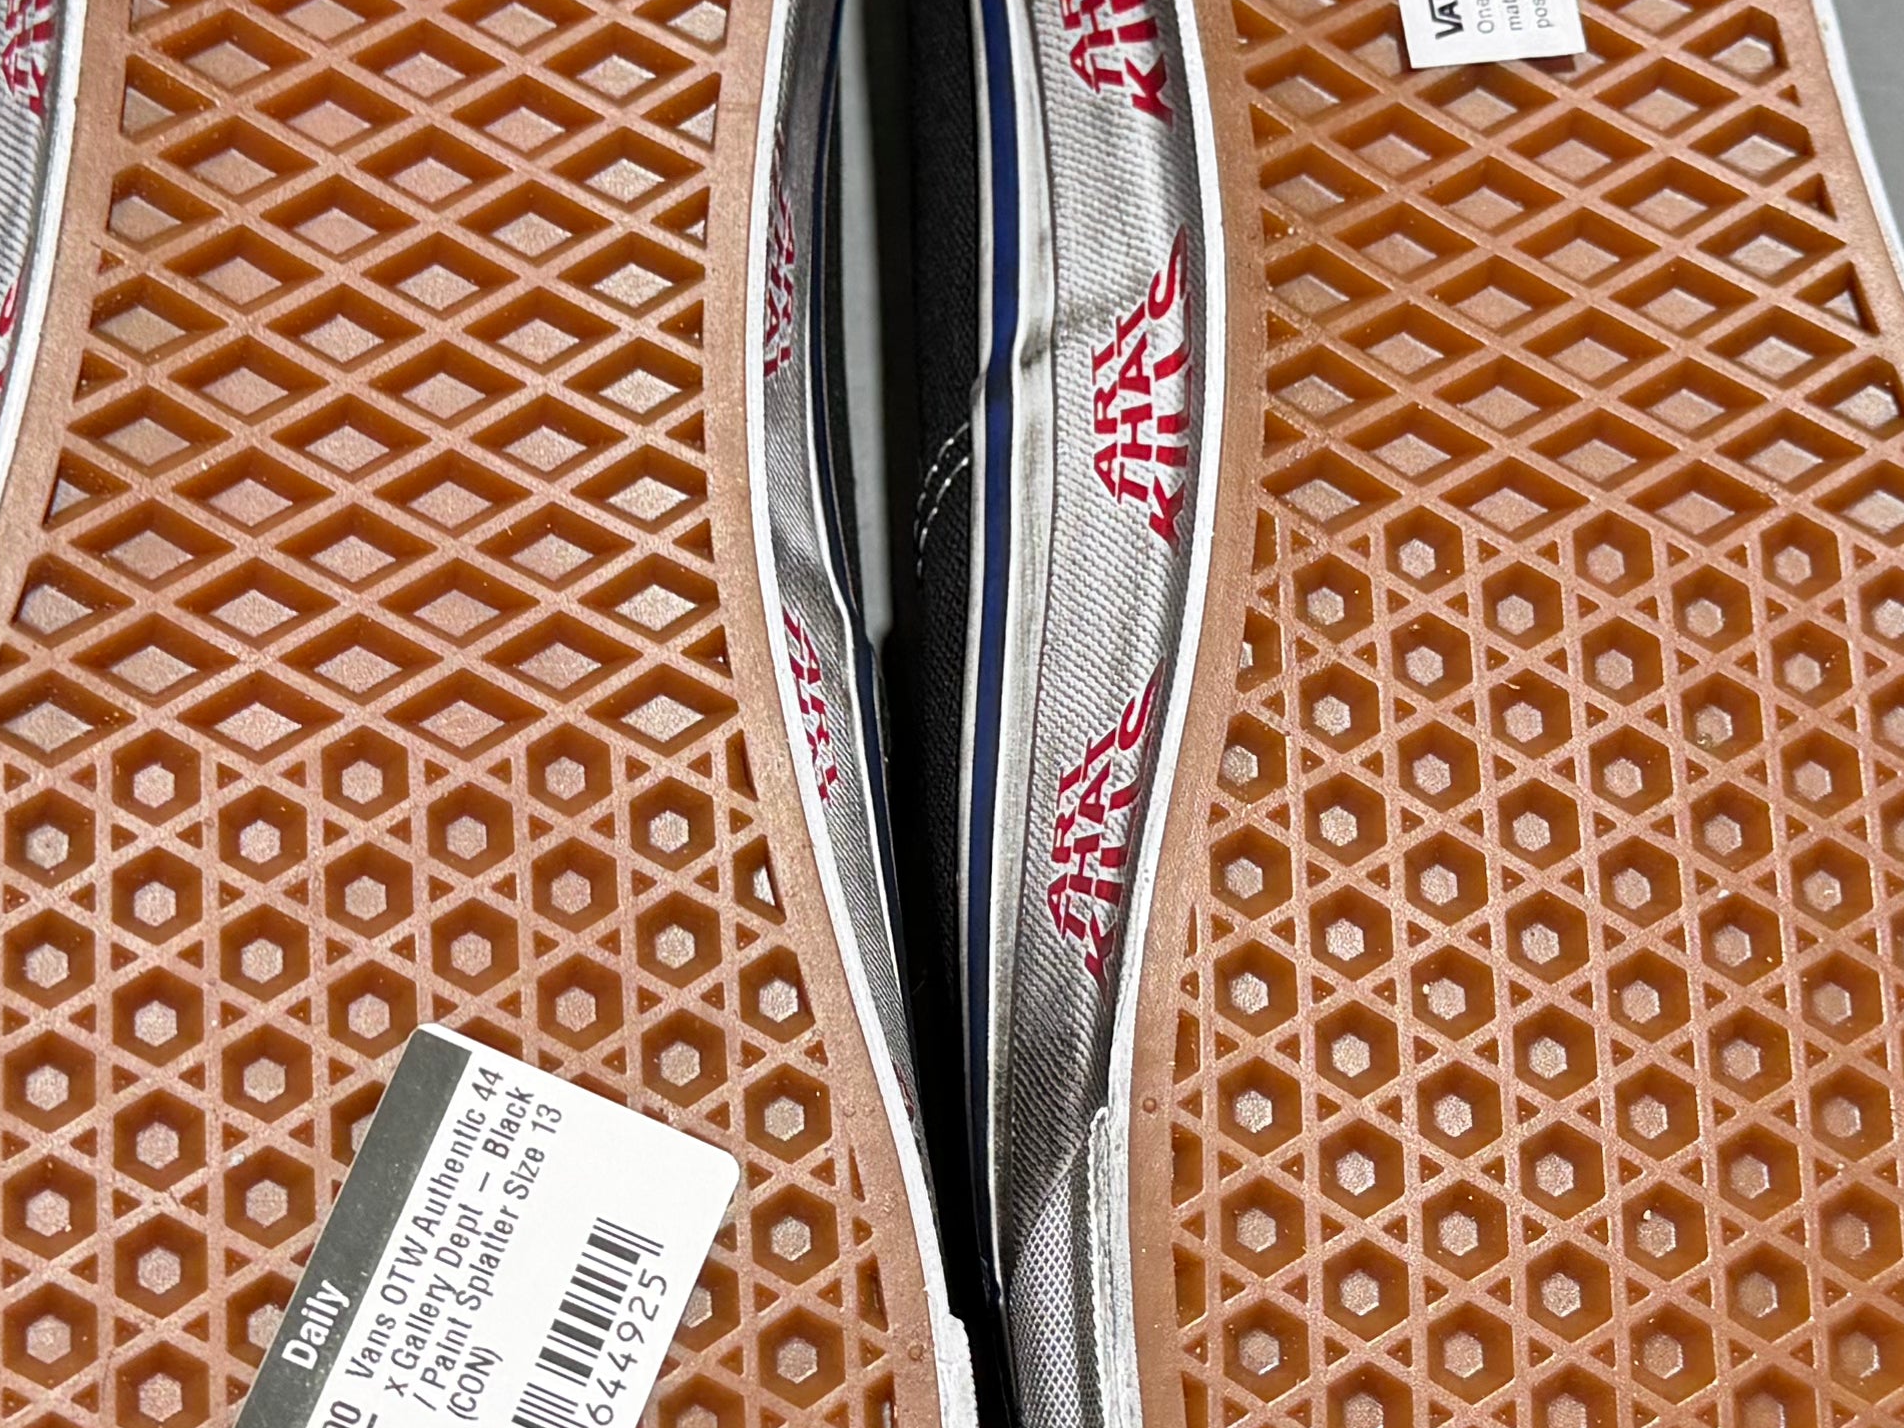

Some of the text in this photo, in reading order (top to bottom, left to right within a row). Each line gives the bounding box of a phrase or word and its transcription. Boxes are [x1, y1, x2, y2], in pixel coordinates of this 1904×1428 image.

[1091, 340, 1120, 498] ART
[1114, 300, 1154, 505] THAT
[1147, 225, 1193, 557] KILLS
[1047, 763, 1083, 940] ART
[1060, 726, 1119, 942] THAT
[281, 1278, 352, 1370] Daily
[344, 1066, 505, 1381] Vans OTW Authentic 44
[389, 1272, 458, 1372] Gallery
[433, 1201, 484, 1270] Dept
[481, 1085, 536, 1161] Black
[419, 1315, 474, 1391] Paint
[454, 1203, 521, 1312] Splatter
[502, 1145, 546, 1201] Size
[530, 1101, 564, 1135] 13
[445, 1344, 505, 1423] (CON)
[584, 1266, 670, 1428] 644925
